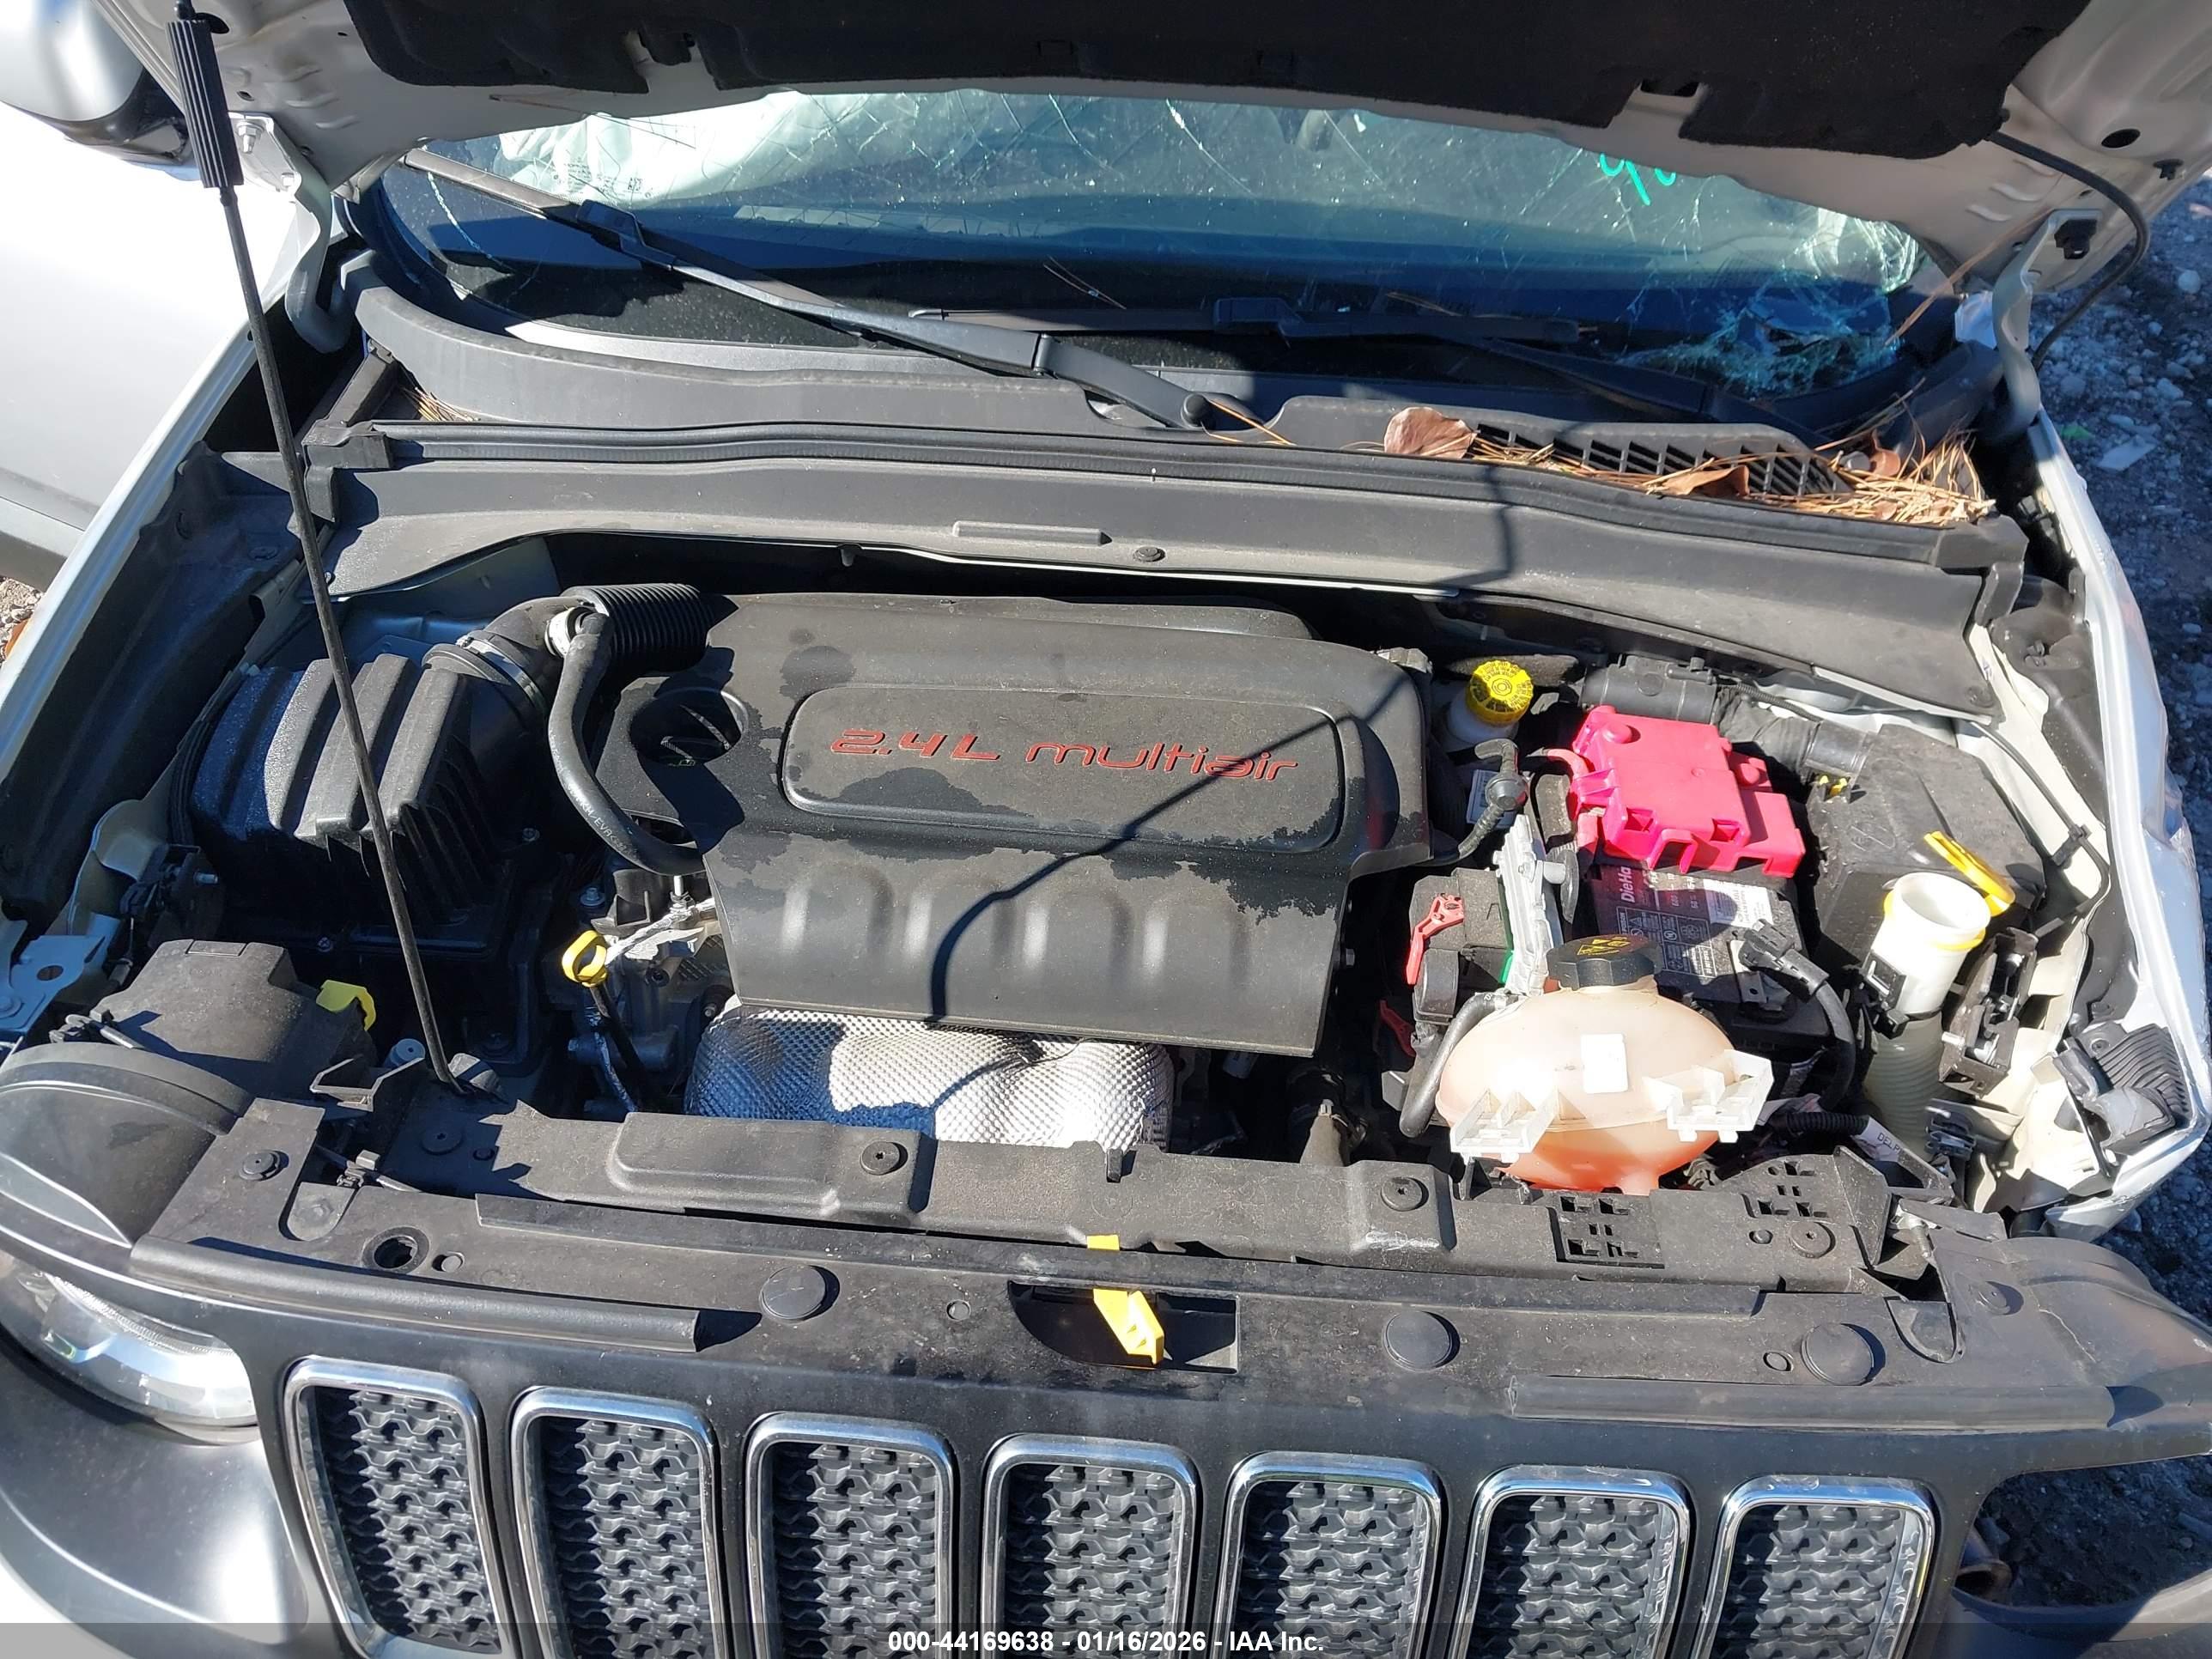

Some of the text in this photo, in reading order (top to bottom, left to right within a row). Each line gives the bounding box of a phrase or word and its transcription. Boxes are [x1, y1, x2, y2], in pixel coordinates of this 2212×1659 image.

[830, 726, 1298, 782] 2.4L multiair
[1617, 866, 1636, 903] DieHa
